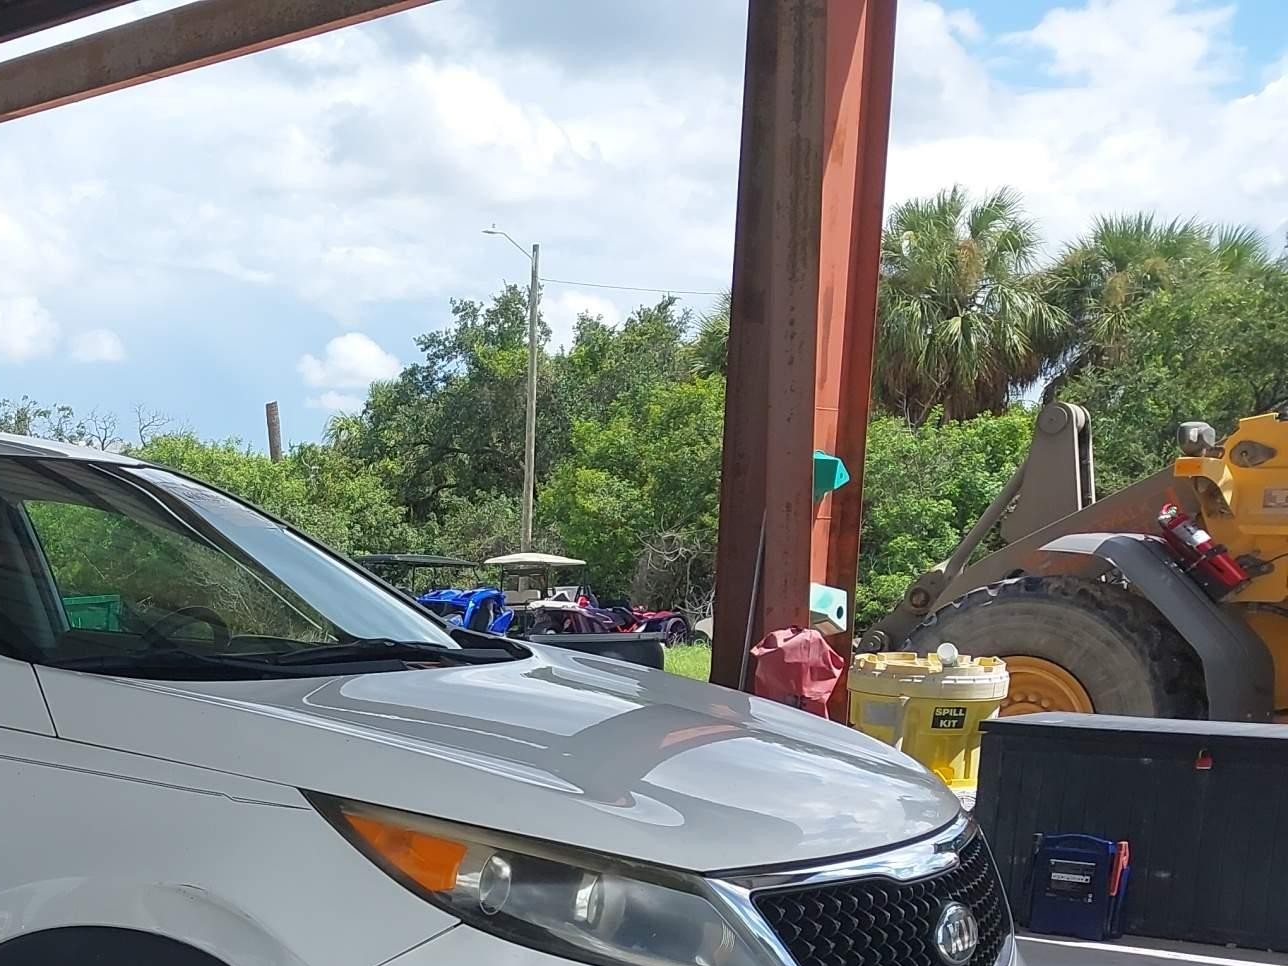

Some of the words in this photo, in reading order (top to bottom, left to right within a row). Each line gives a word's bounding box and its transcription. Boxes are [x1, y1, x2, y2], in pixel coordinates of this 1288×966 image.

[935, 708, 965, 716] SPILL
[939, 719, 958, 728] KIT
[946, 916, 977, 954] KIA
